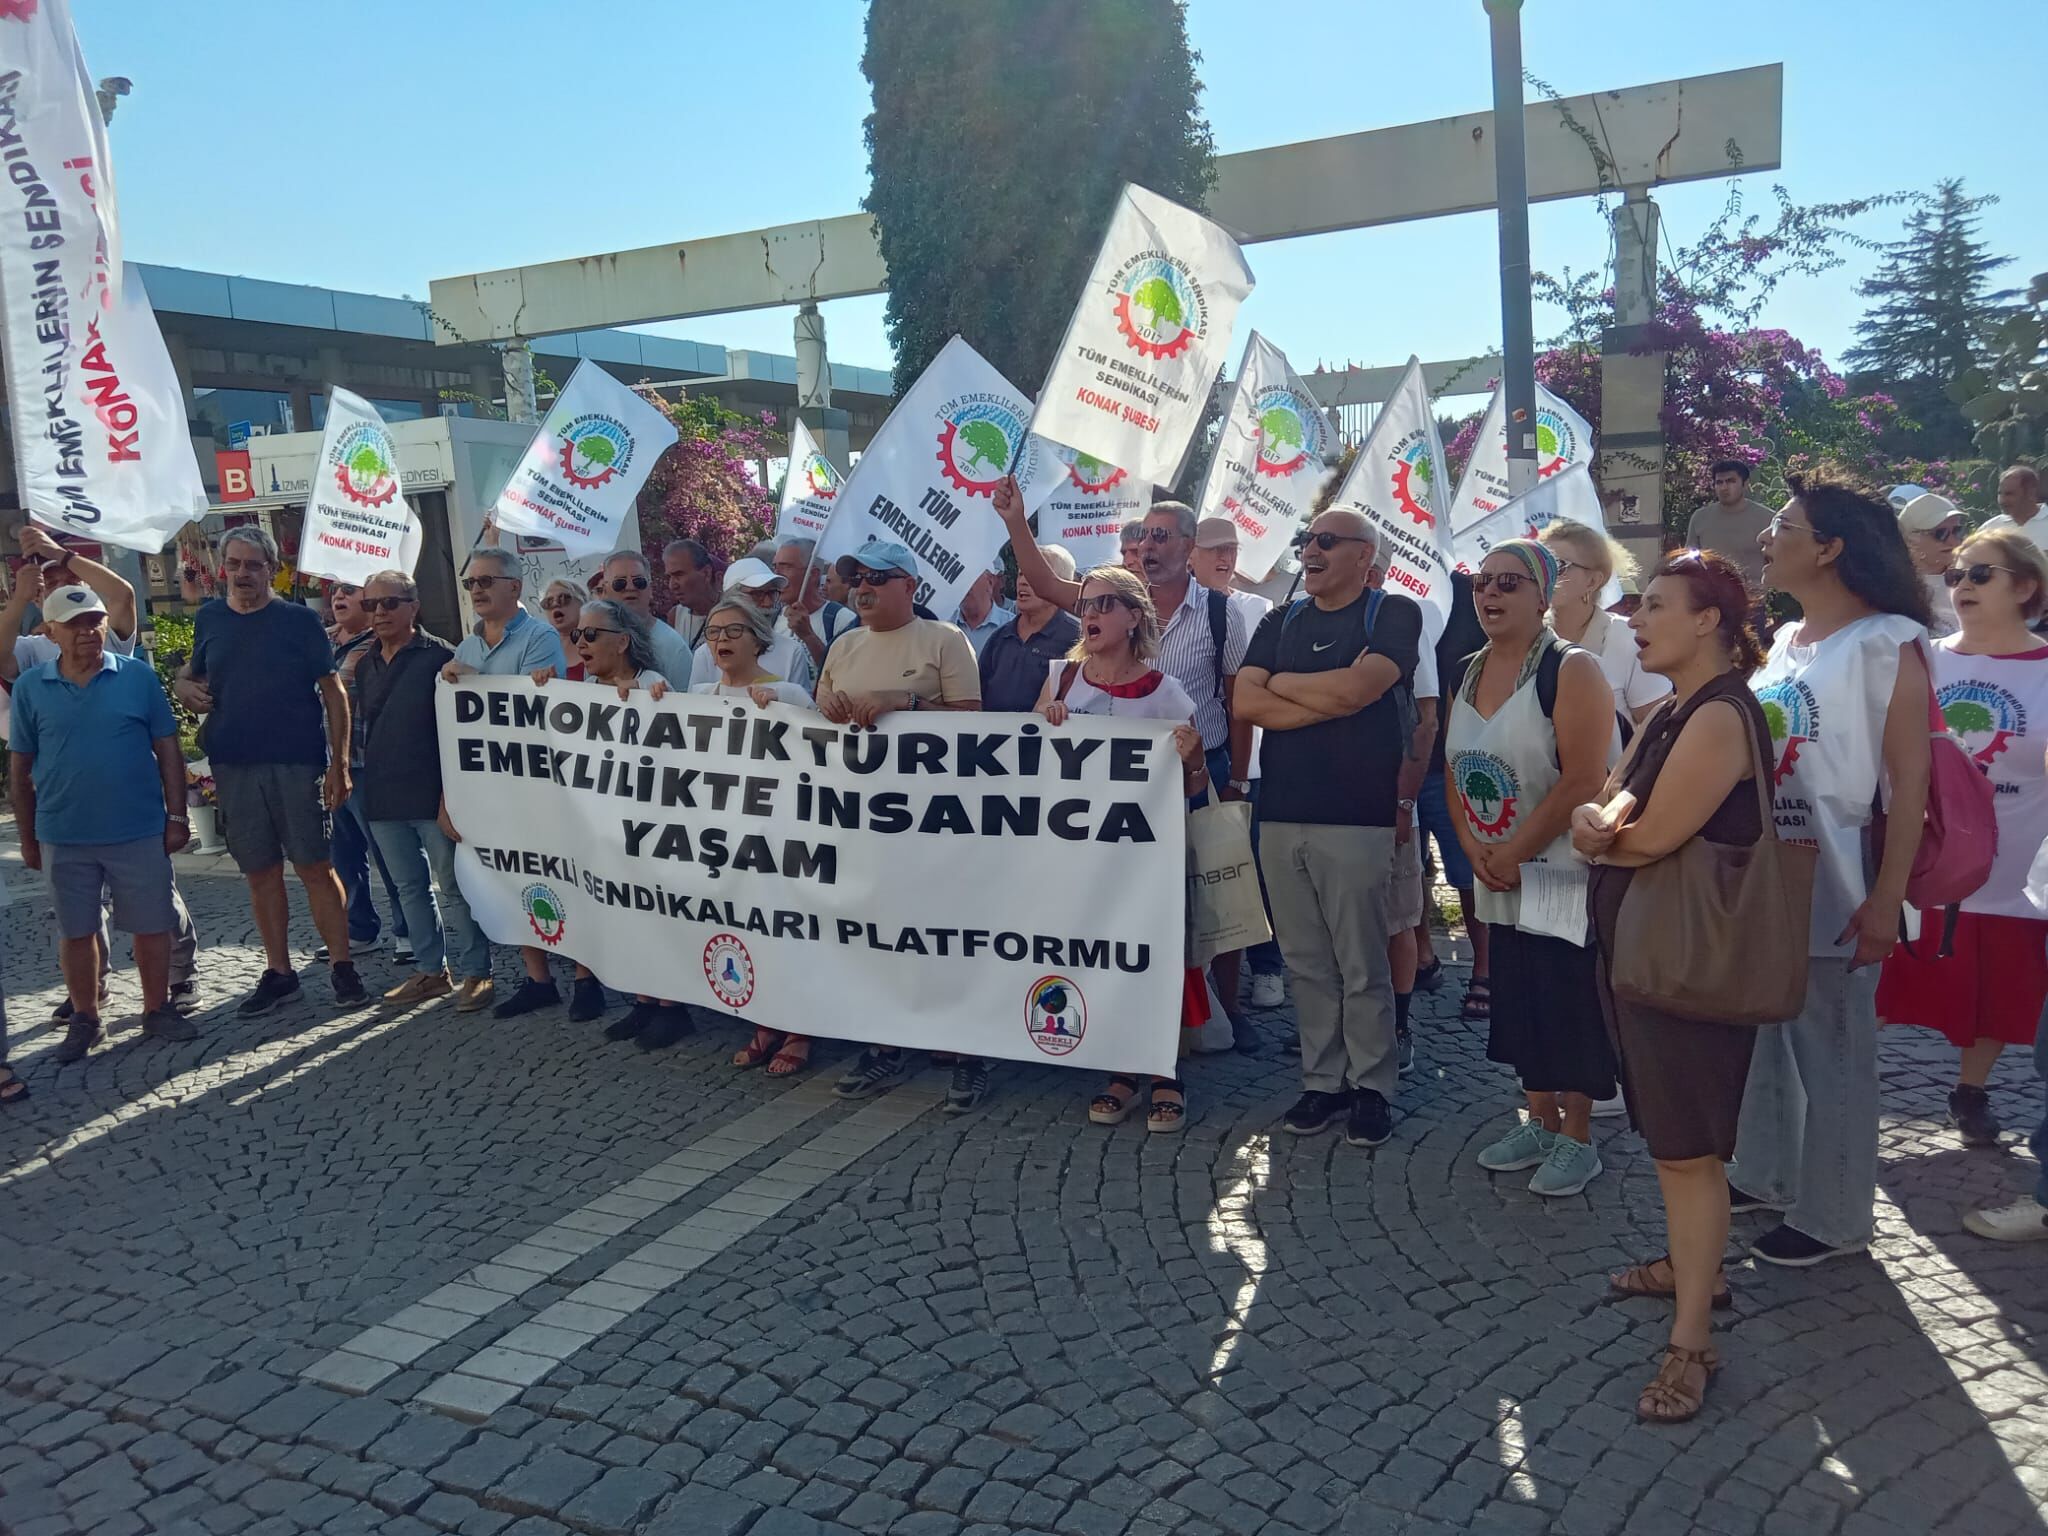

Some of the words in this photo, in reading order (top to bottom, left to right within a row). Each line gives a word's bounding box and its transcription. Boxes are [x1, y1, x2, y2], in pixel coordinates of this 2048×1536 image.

[1123, 250, 1191, 277] EMEKLİLERİN
[1188, 276, 1208, 341] SENDİKASI
[1136, 325, 1162, 343] 2017
[1077, 346, 1107, 365] TÜM
[1109, 359, 1190, 404] EMEKLİLERİN
[1096, 371, 1160, 407] SENDİKASI
[574, 413, 631, 437] EMEKLİLERİN
[960, 393, 1030, 426] EMEKLİLERİ
[1076, 387, 1121, 416] KONAK
[1122, 405, 1160, 434] ŞUBESİ
[225, 468, 248, 493] B
[959, 462, 977, 477] 2017
[1475, 469, 1496, 483] TÜM
[527, 469, 549, 487] TÜM
[549, 484, 609, 523] EMEKLİLERİN
[537, 490, 586, 523] SENDİKASI
[918, 487, 961, 530] TÜM
[1050, 501, 1072, 510] TÜM
[332, 521, 387, 539] SENDİKASI
[522, 499, 556, 522] KONAK
[555, 516, 591, 536] ŞUBESİ
[1062, 525, 1093, 538] KONAK
[323, 534, 354, 551] KONAK
[355, 541, 391, 559] ŞUBESİ
[868, 494, 965, 585] EMEKLİLERİN
[1387, 565, 1431, 598] ŞUBESİ
[1795, 680, 1820, 743] SENDİKASI
[1999, 688, 2027, 738] SENDİKASI
[454, 690, 791, 762] DEMOKRATİK
[802, 723, 1154, 782] TÜRKİYE
[458, 738, 780, 817] EMEKLİLİKTE
[797, 772, 1157, 843] İNSANCA
[622, 819, 838, 885] YAŞAM
[474, 846, 579, 888] EMEKLİ
[583, 869, 821, 941] SENDİKALARI
[836, 918, 1152, 973] PLATFORMU
